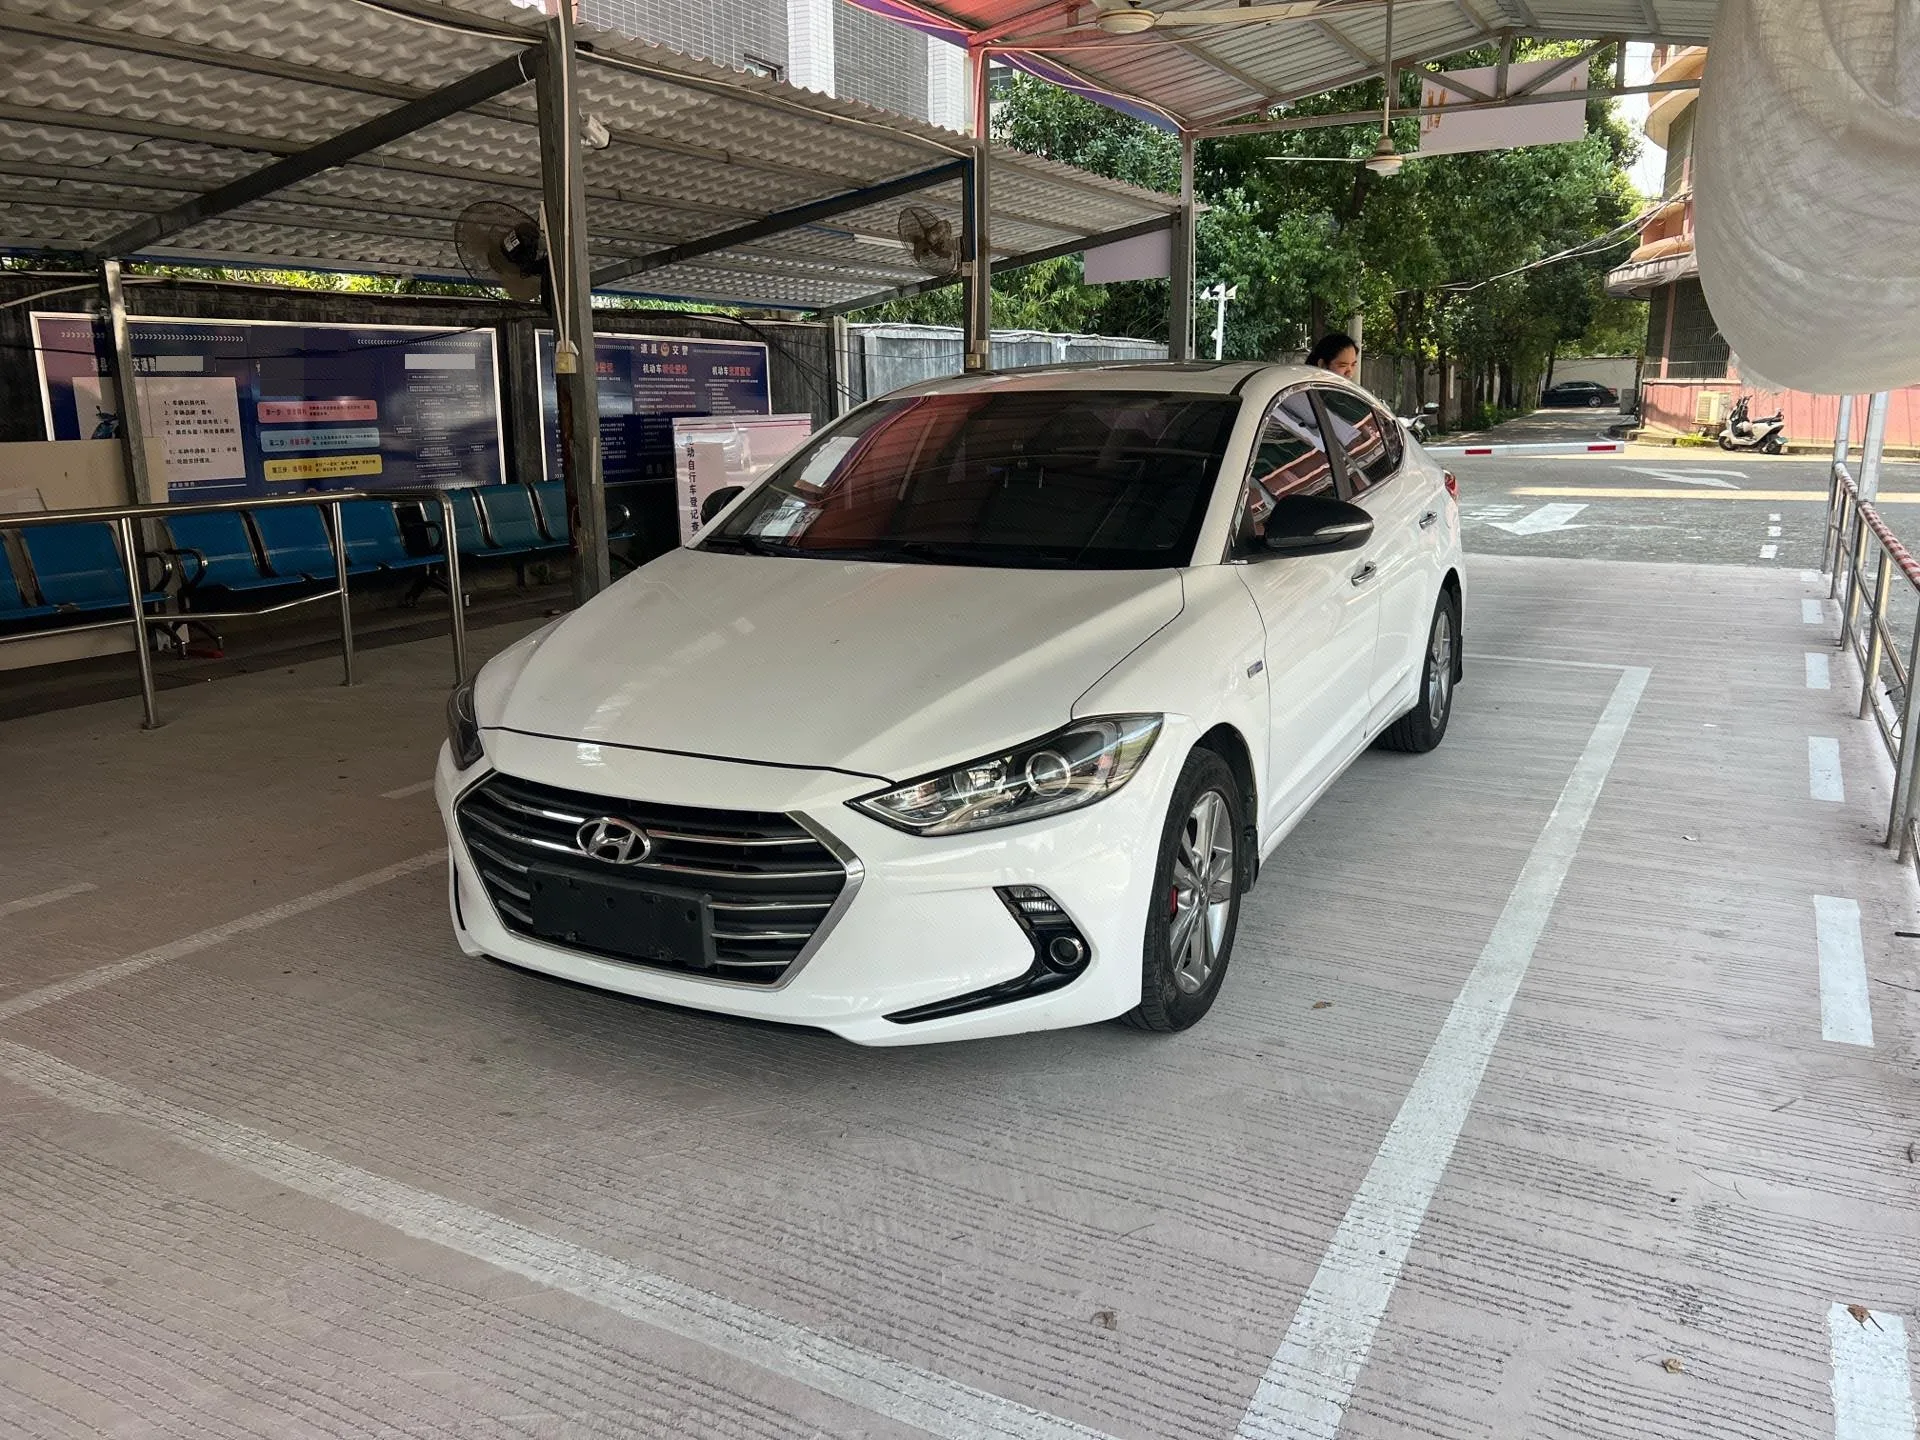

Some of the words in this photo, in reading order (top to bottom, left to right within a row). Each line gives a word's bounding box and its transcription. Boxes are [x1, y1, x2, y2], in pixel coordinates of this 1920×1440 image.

[641, 343, 657, 355] 道县
[672, 345, 688, 356] 交警
[686, 432, 699, 537] 电动自行车登记查
